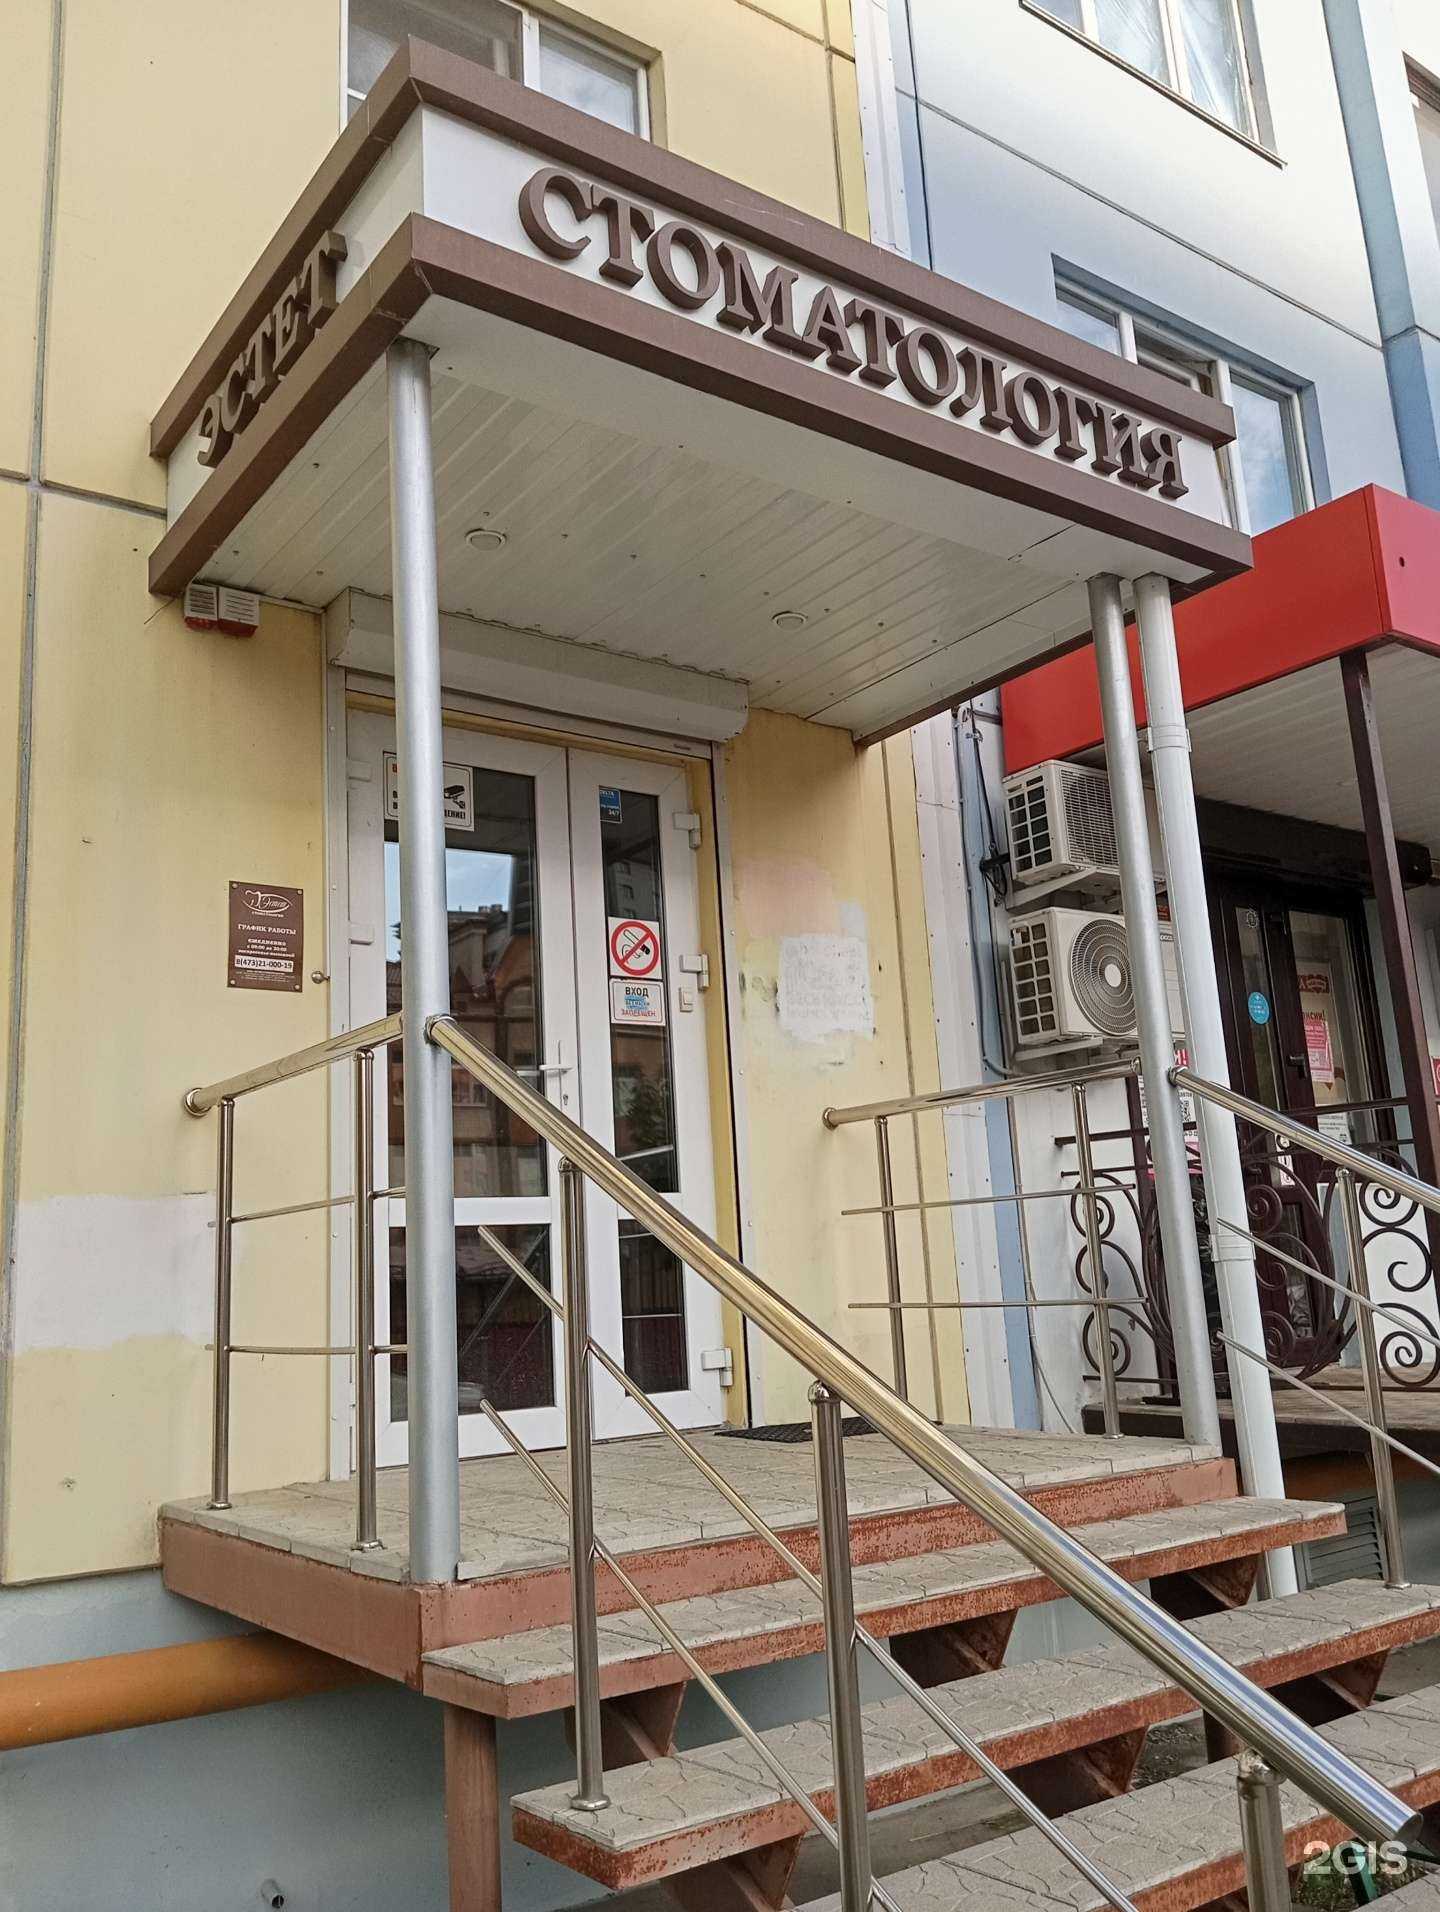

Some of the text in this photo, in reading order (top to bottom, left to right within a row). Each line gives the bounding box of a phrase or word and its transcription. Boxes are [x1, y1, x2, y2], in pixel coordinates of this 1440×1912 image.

[197, 230, 348, 468] ЭСТЕТ
[519, 166, 1189, 500] СТОМАТОЛОГИЯ
[238, 924, 296, 935] ГРАФИК РАБОТЫ
[625, 986, 649, 998] ВХОД
